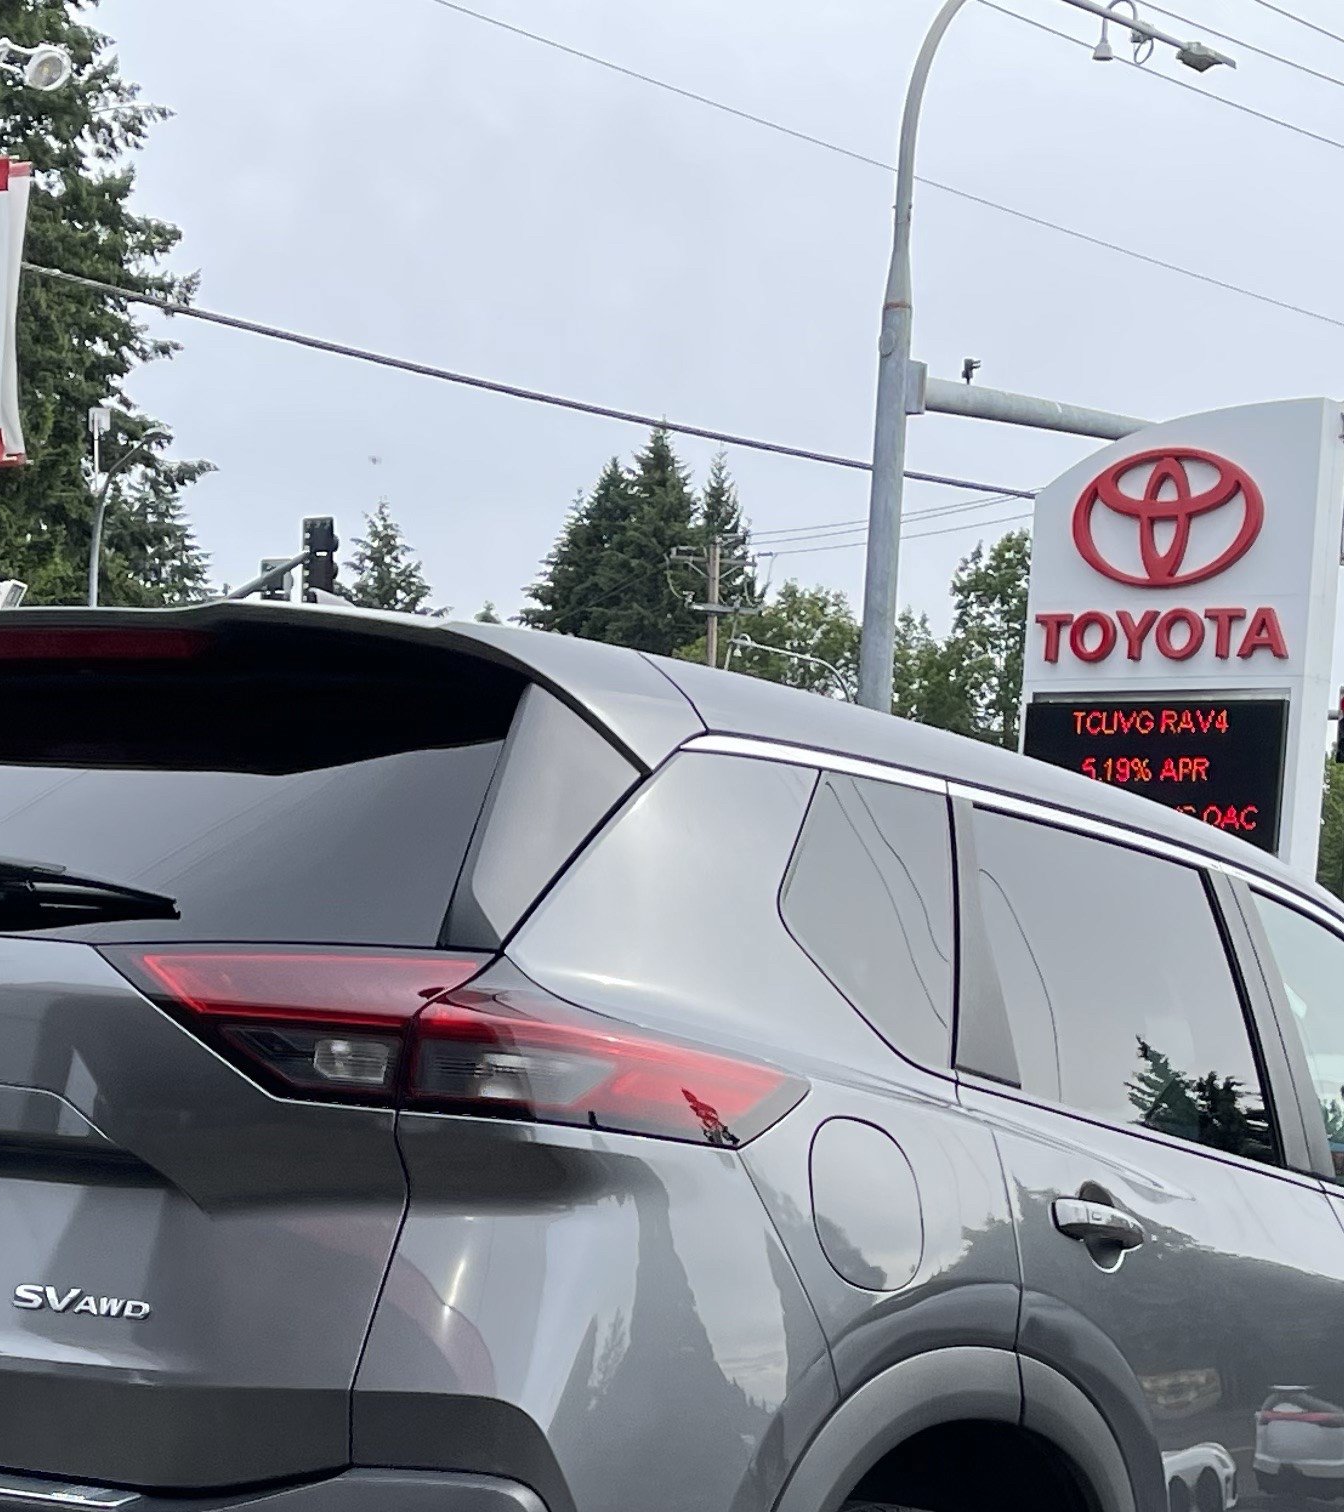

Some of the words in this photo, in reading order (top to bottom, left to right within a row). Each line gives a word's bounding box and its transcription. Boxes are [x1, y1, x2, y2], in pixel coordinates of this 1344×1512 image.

[1036, 607, 1289, 663] TOYOTA
[1159, 709, 1229, 734] RAV4
[1159, 757, 1210, 782] APR
